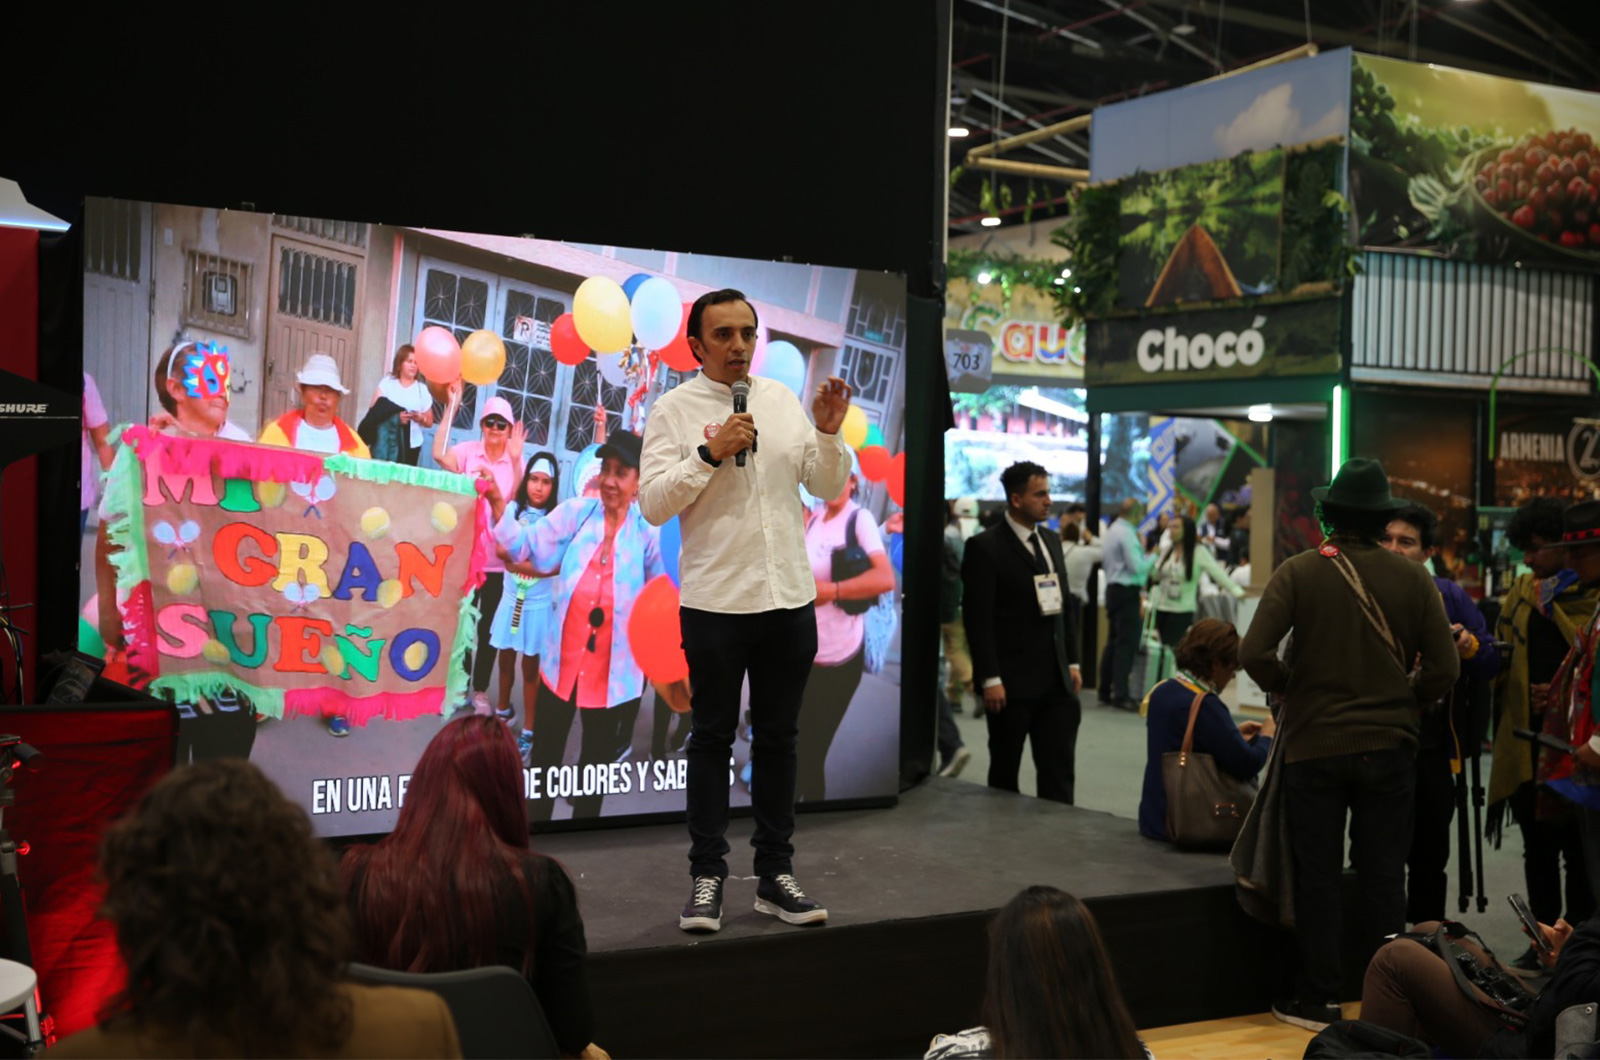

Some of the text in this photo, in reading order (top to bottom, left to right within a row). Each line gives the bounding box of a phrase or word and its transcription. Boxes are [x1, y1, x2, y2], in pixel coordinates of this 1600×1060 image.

[953, 353, 980, 370] 703
[961, 304, 1085, 365] Cauc
[1137, 314, 1266, 373] Chocó
[0, 403, 48, 413] SHURE
[1500, 431, 1565, 462] ARMENIA
[212, 521, 454, 601] GRAN
[157, 603, 441, 682] SUEÑO
[312, 779, 341, 814] EN
[347, 775, 393, 812] UNA
[546, 761, 632, 798] COLORES
[636, 760, 650, 792] Y
